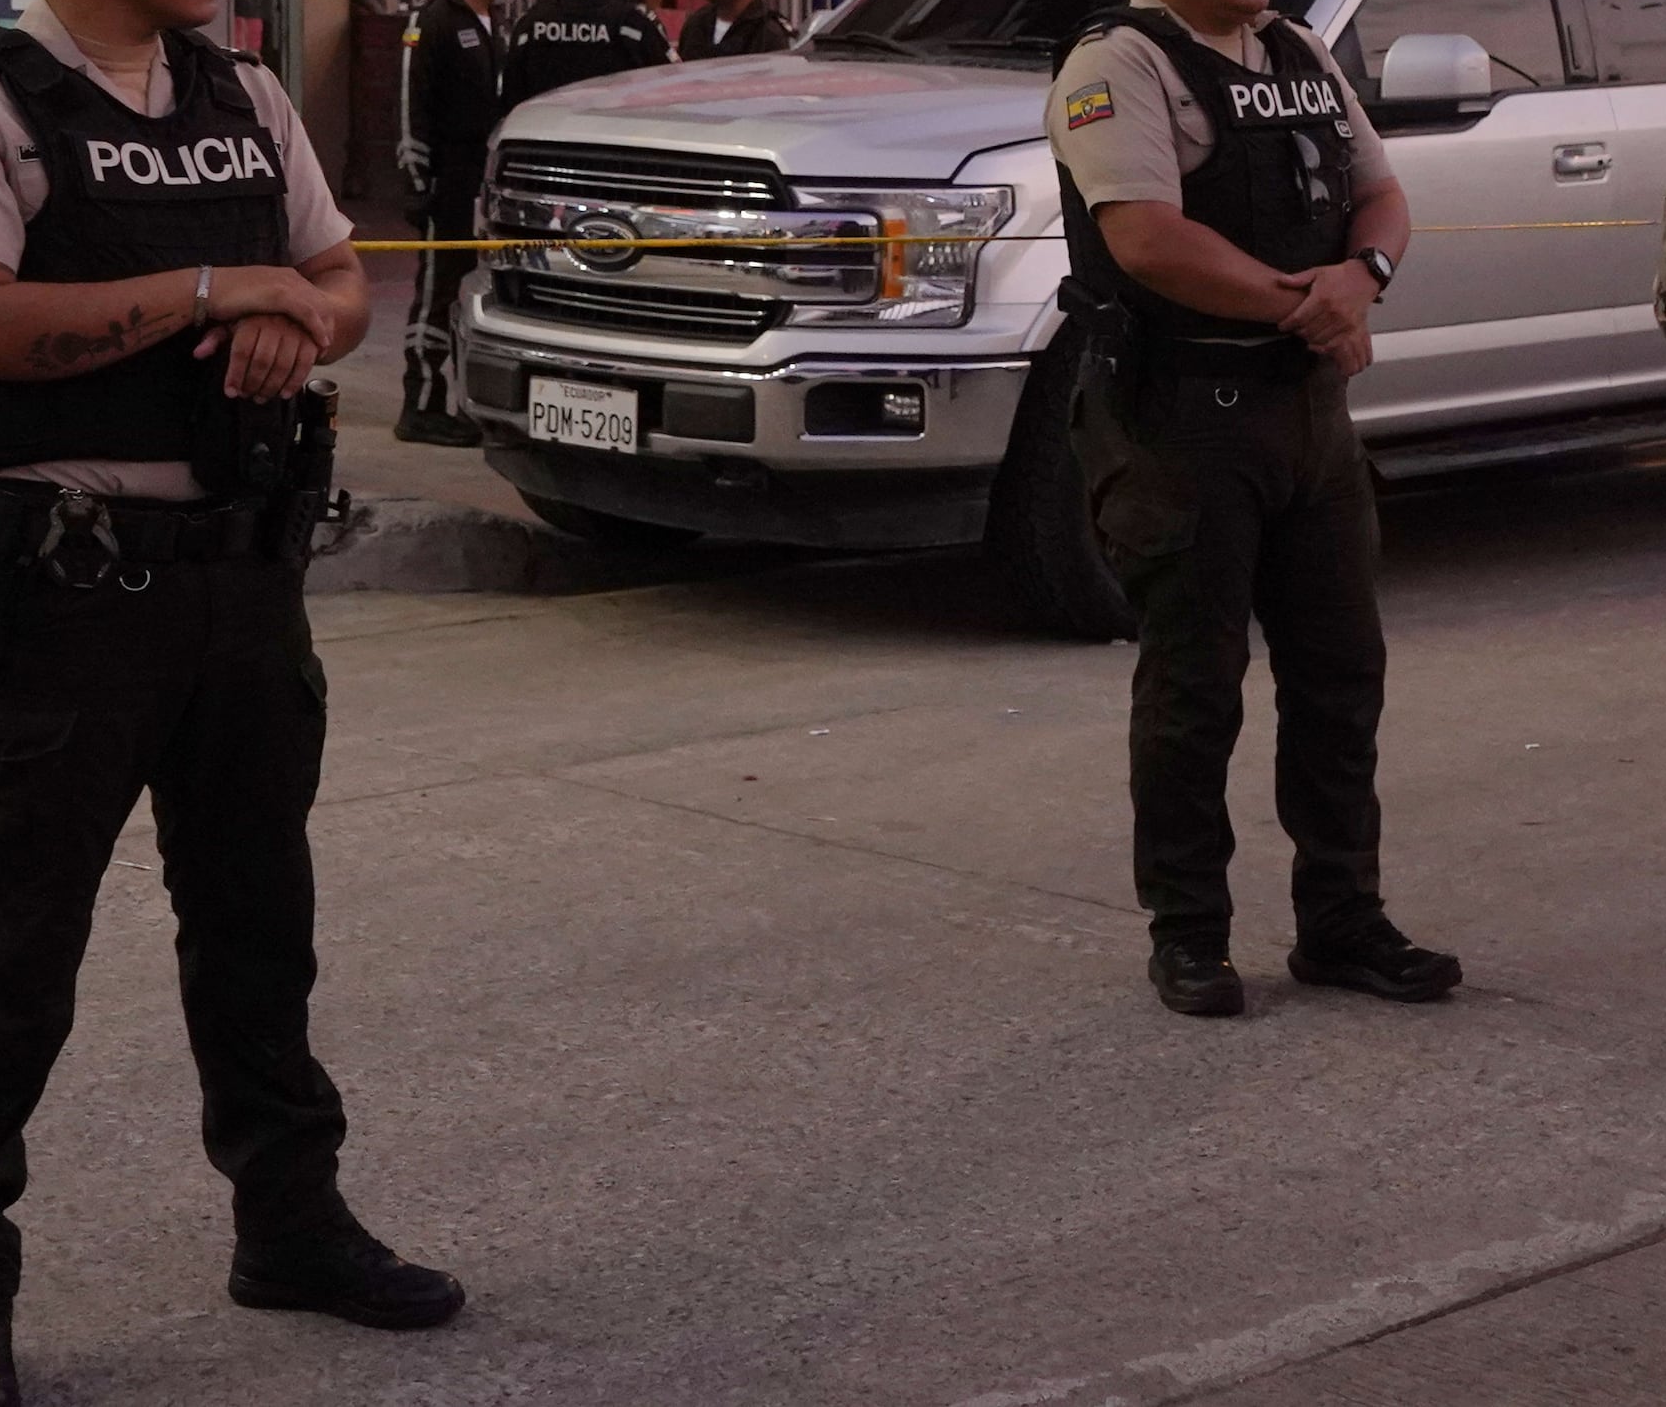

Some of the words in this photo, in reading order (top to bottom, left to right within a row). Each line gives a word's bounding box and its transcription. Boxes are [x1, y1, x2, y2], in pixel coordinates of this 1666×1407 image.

[533, 21, 611, 44] POLICIA
[1229, 79, 1323, 119] POLICIA
[86, 136, 276, 186] POLICIA
